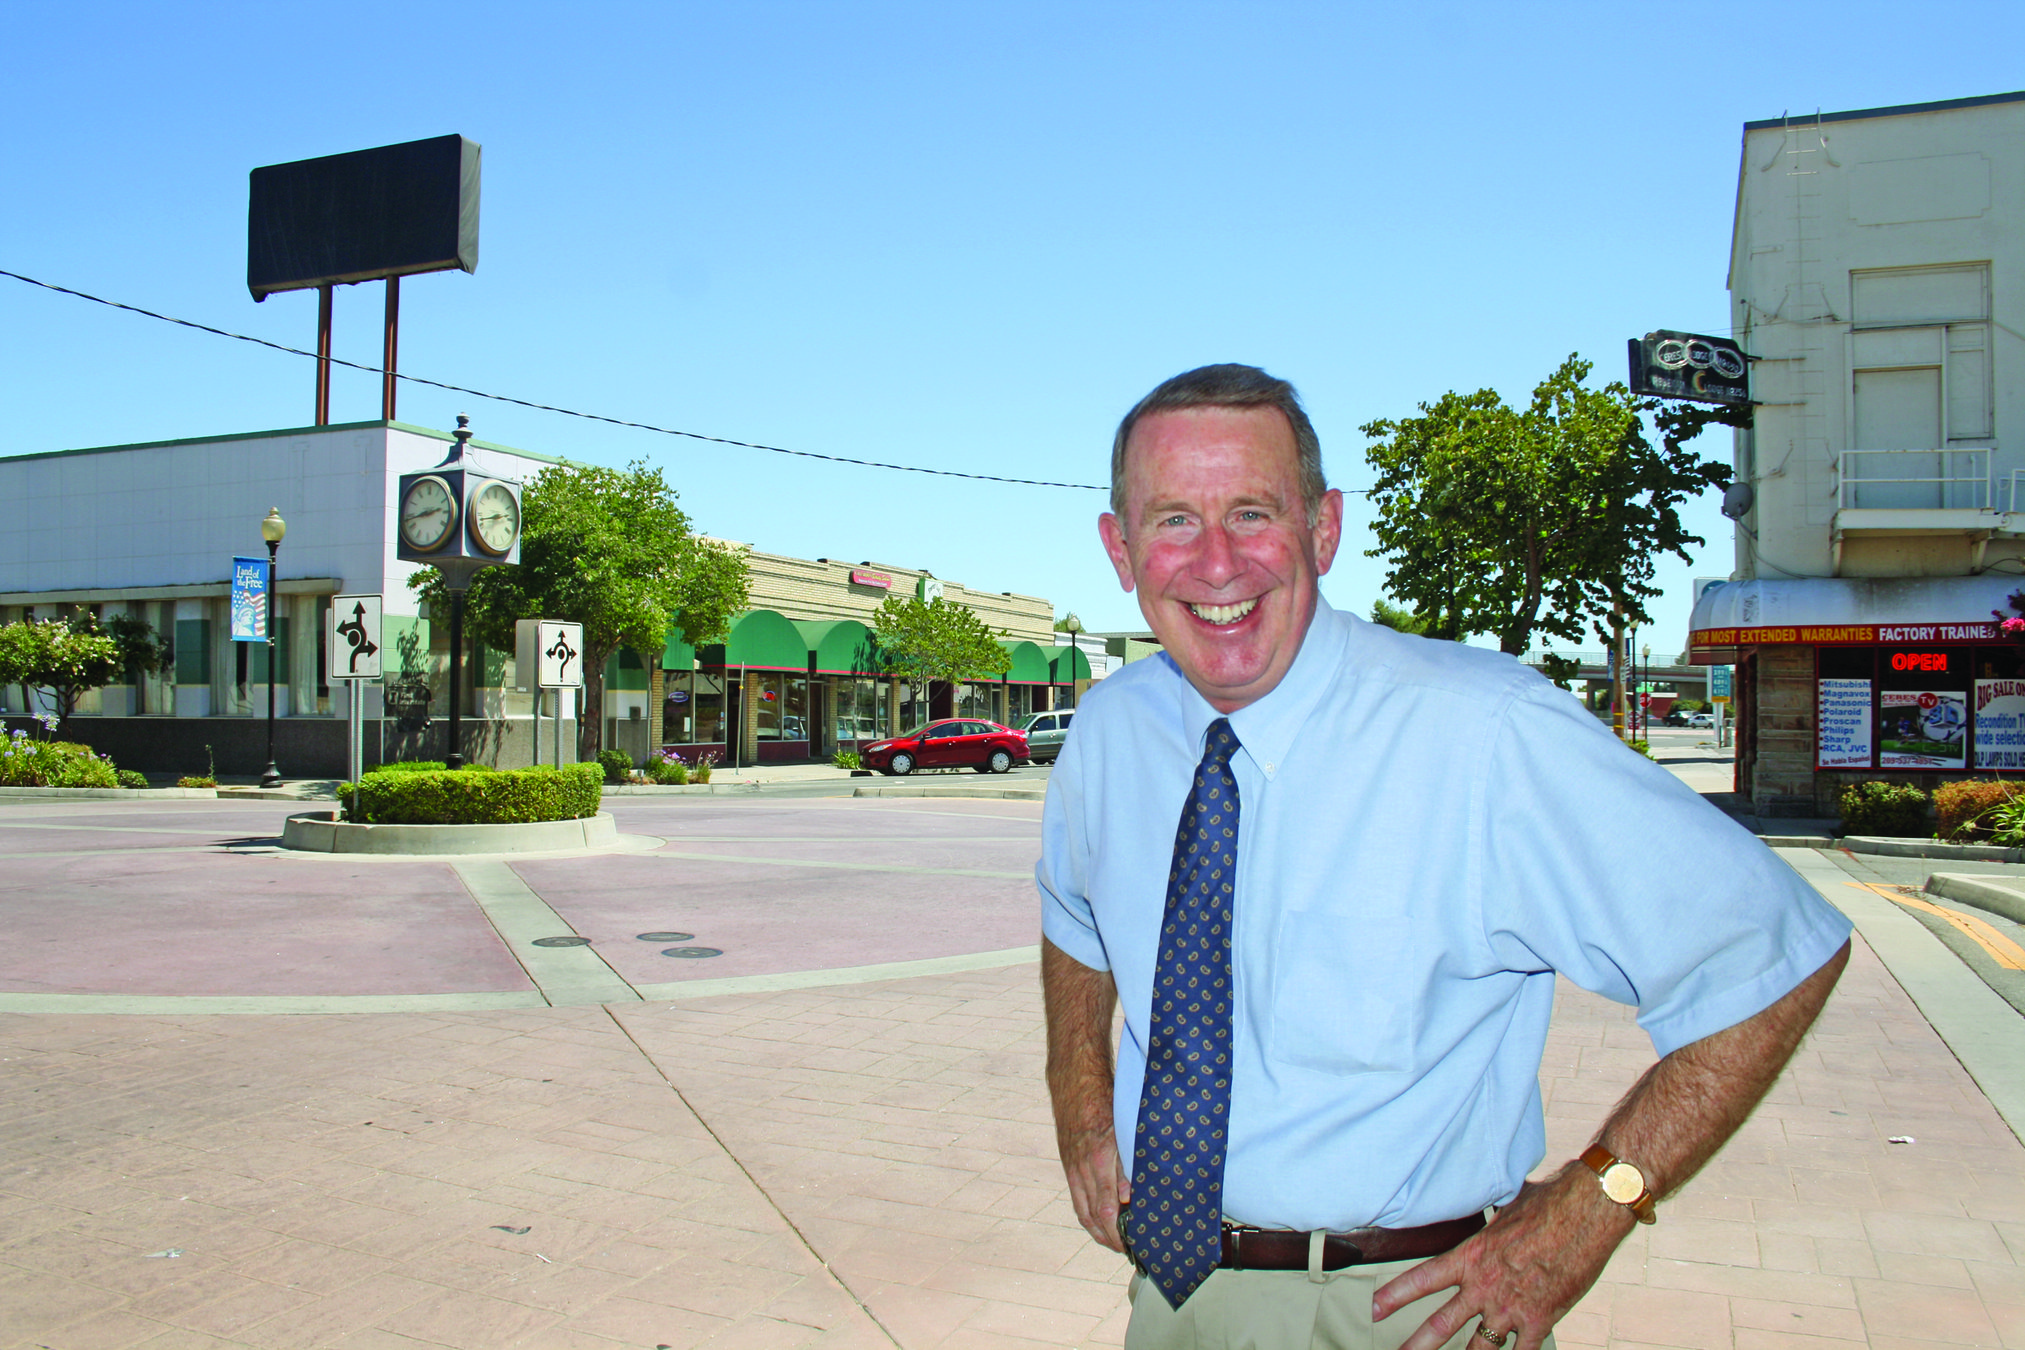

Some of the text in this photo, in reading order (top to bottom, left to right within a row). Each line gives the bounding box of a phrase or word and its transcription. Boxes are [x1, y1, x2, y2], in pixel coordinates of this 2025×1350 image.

[236, 566, 260, 578] Land of
[237, 576, 263, 589] the Free
[1696, 632, 1710, 644] FOR
[1711, 631, 1737, 643] MOST
[1740, 629, 1797, 643] EXTENDED
[1801, 627, 1874, 642] WARRANTIES
[1879, 627, 1936, 641] FACTORY
[1891, 652, 1948, 671] OPEN
[1824, 690, 1870, 699] Magnavox
[1977, 684, 1992, 711] BIG
[1993, 681, 2015, 698] SALE
[1824, 699, 1872, 707] Panasonic
[1920, 696, 1935, 706] TV
[1824, 708, 1862, 716] Polaroid
[1824, 717, 1862, 725] Proscan
[1976, 713, 2017, 728] Recondition
[1824, 726, 1855, 736] Philips
[1824, 735, 1851, 745] Sharp
[1976, 730, 1993, 745] wide
[1824, 744, 1867, 753] RCA, JVC
